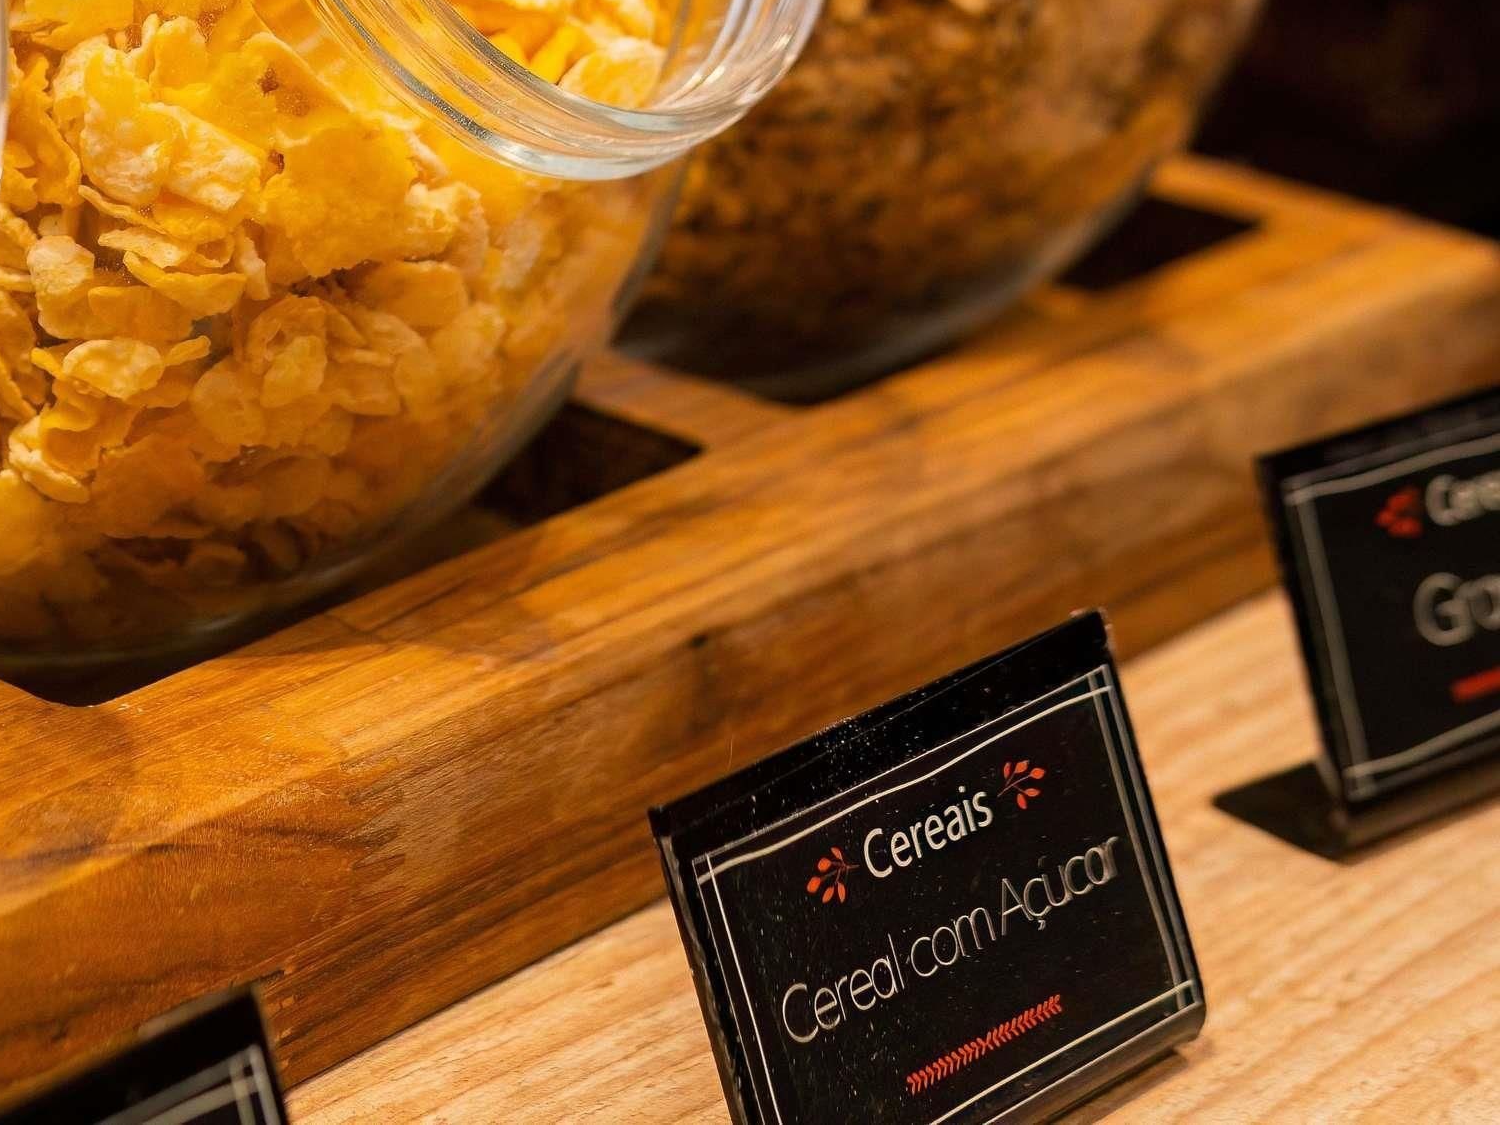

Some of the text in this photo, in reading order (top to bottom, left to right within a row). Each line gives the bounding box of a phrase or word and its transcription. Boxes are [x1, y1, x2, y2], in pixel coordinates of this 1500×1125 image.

[863, 785, 994, 878] Cereais
[782, 932, 905, 1043] Cereal
[910, 907, 997, 977] com
